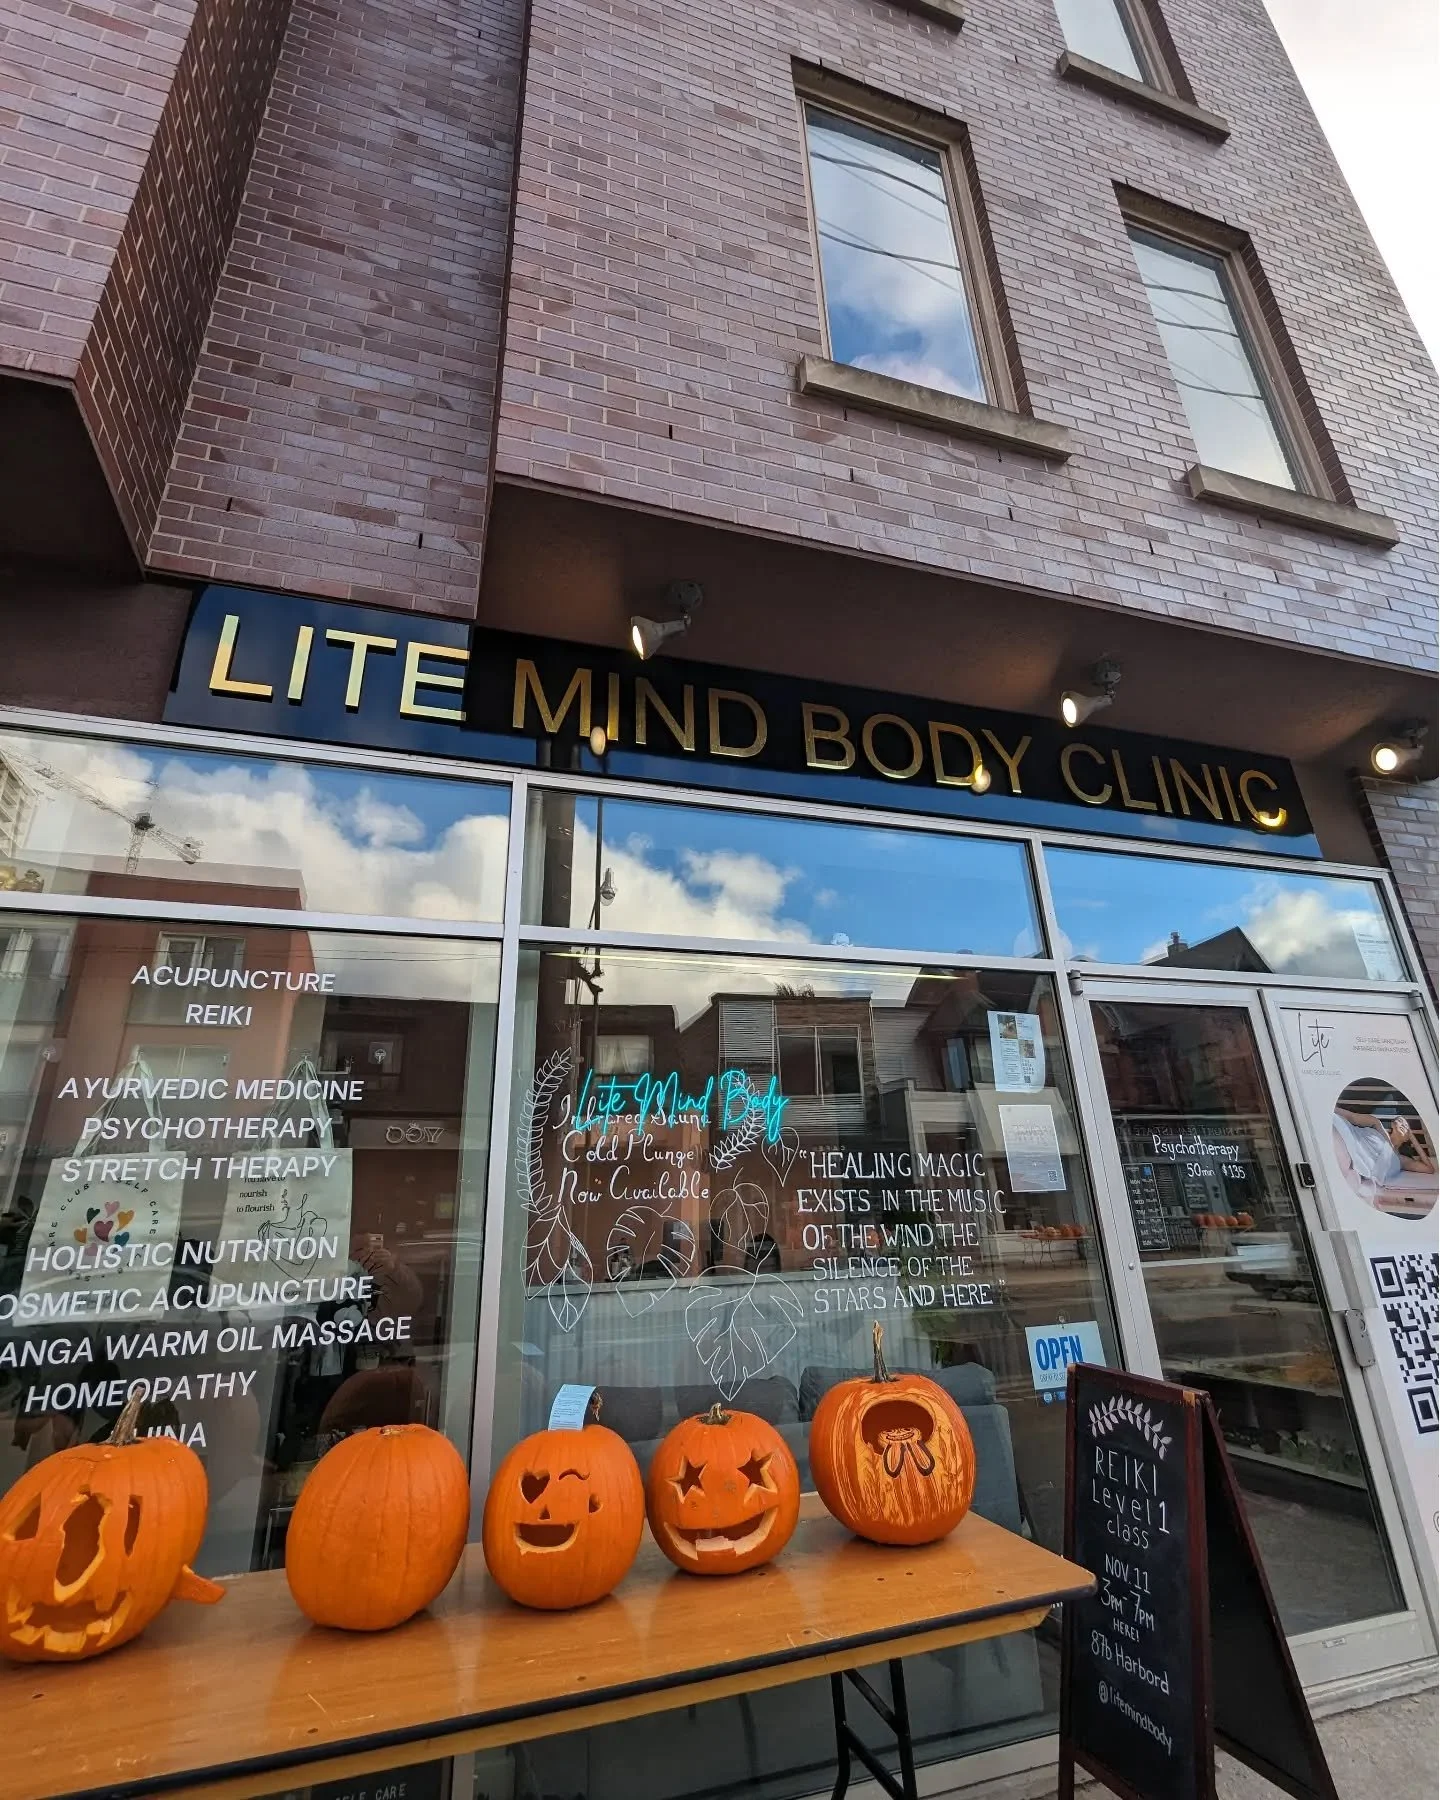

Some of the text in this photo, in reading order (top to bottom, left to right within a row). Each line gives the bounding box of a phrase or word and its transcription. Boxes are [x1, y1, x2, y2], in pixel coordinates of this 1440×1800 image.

[209, 614, 1287, 828] LITE MIND BODY CLINIC
[131, 965, 336, 993] ACUPUNCTURE
[184, 1003, 253, 1027] REIKI
[1298, 1011, 1336, 1068] Lite
[57, 1077, 365, 1101] AYURVEDIC MEDICINE
[575, 1068, 789, 1143] Lite Mind Body
[81, 1117, 334, 1140] PSYCHOTHERAPY
[562, 1128, 694, 1168] Cold Plunge
[1152, 1134, 1239, 1161] Psychotherapy
[61, 1155, 338, 1183] STRETCH THERAPY
[918, 1152, 986, 1177] MAGIC
[1221, 1162, 1246, 1179] $135
[239, 1188, 268, 1198] nourish
[558, 1165, 709, 1204] Now Available
[244, 1203, 275, 1213] flourish
[797, 1189, 1007, 1214] EXISTS IN THE MUSIC
[802, 1223, 833, 1250] OF
[836, 1223, 877, 1249] THE
[936, 1222, 980, 1247] THE
[26, 1242, 174, 1273] HOLISTIC
[180, 1236, 339, 1266] NUTRITION
[813, 1256, 974, 1281] SILENCE OF THE
[153, 1276, 374, 1311] ACUPUNCTURE
[814, 1286, 887, 1314] STARS
[893, 1284, 935, 1308] AND
[106, 1330, 207, 1361] WARM
[216, 1327, 262, 1353] OIL
[271, 1316, 412, 1349] MASSAGE
[1035, 1334, 1084, 1371] OPEN
[24, 1370, 258, 1413] HOMEOPATHY
[1095, 1445, 1157, 1496] REIKI
[1092, 1478, 1170, 1534] Level 1
[1107, 1513, 1149, 1549] class
[1133, 1567, 1151, 1594] 11
[1113, 1618, 1140, 1643] HERE!
[1091, 1629, 1169, 1696] 87b Harbord
[1098, 1680, 1172, 1756] @litemindbody
